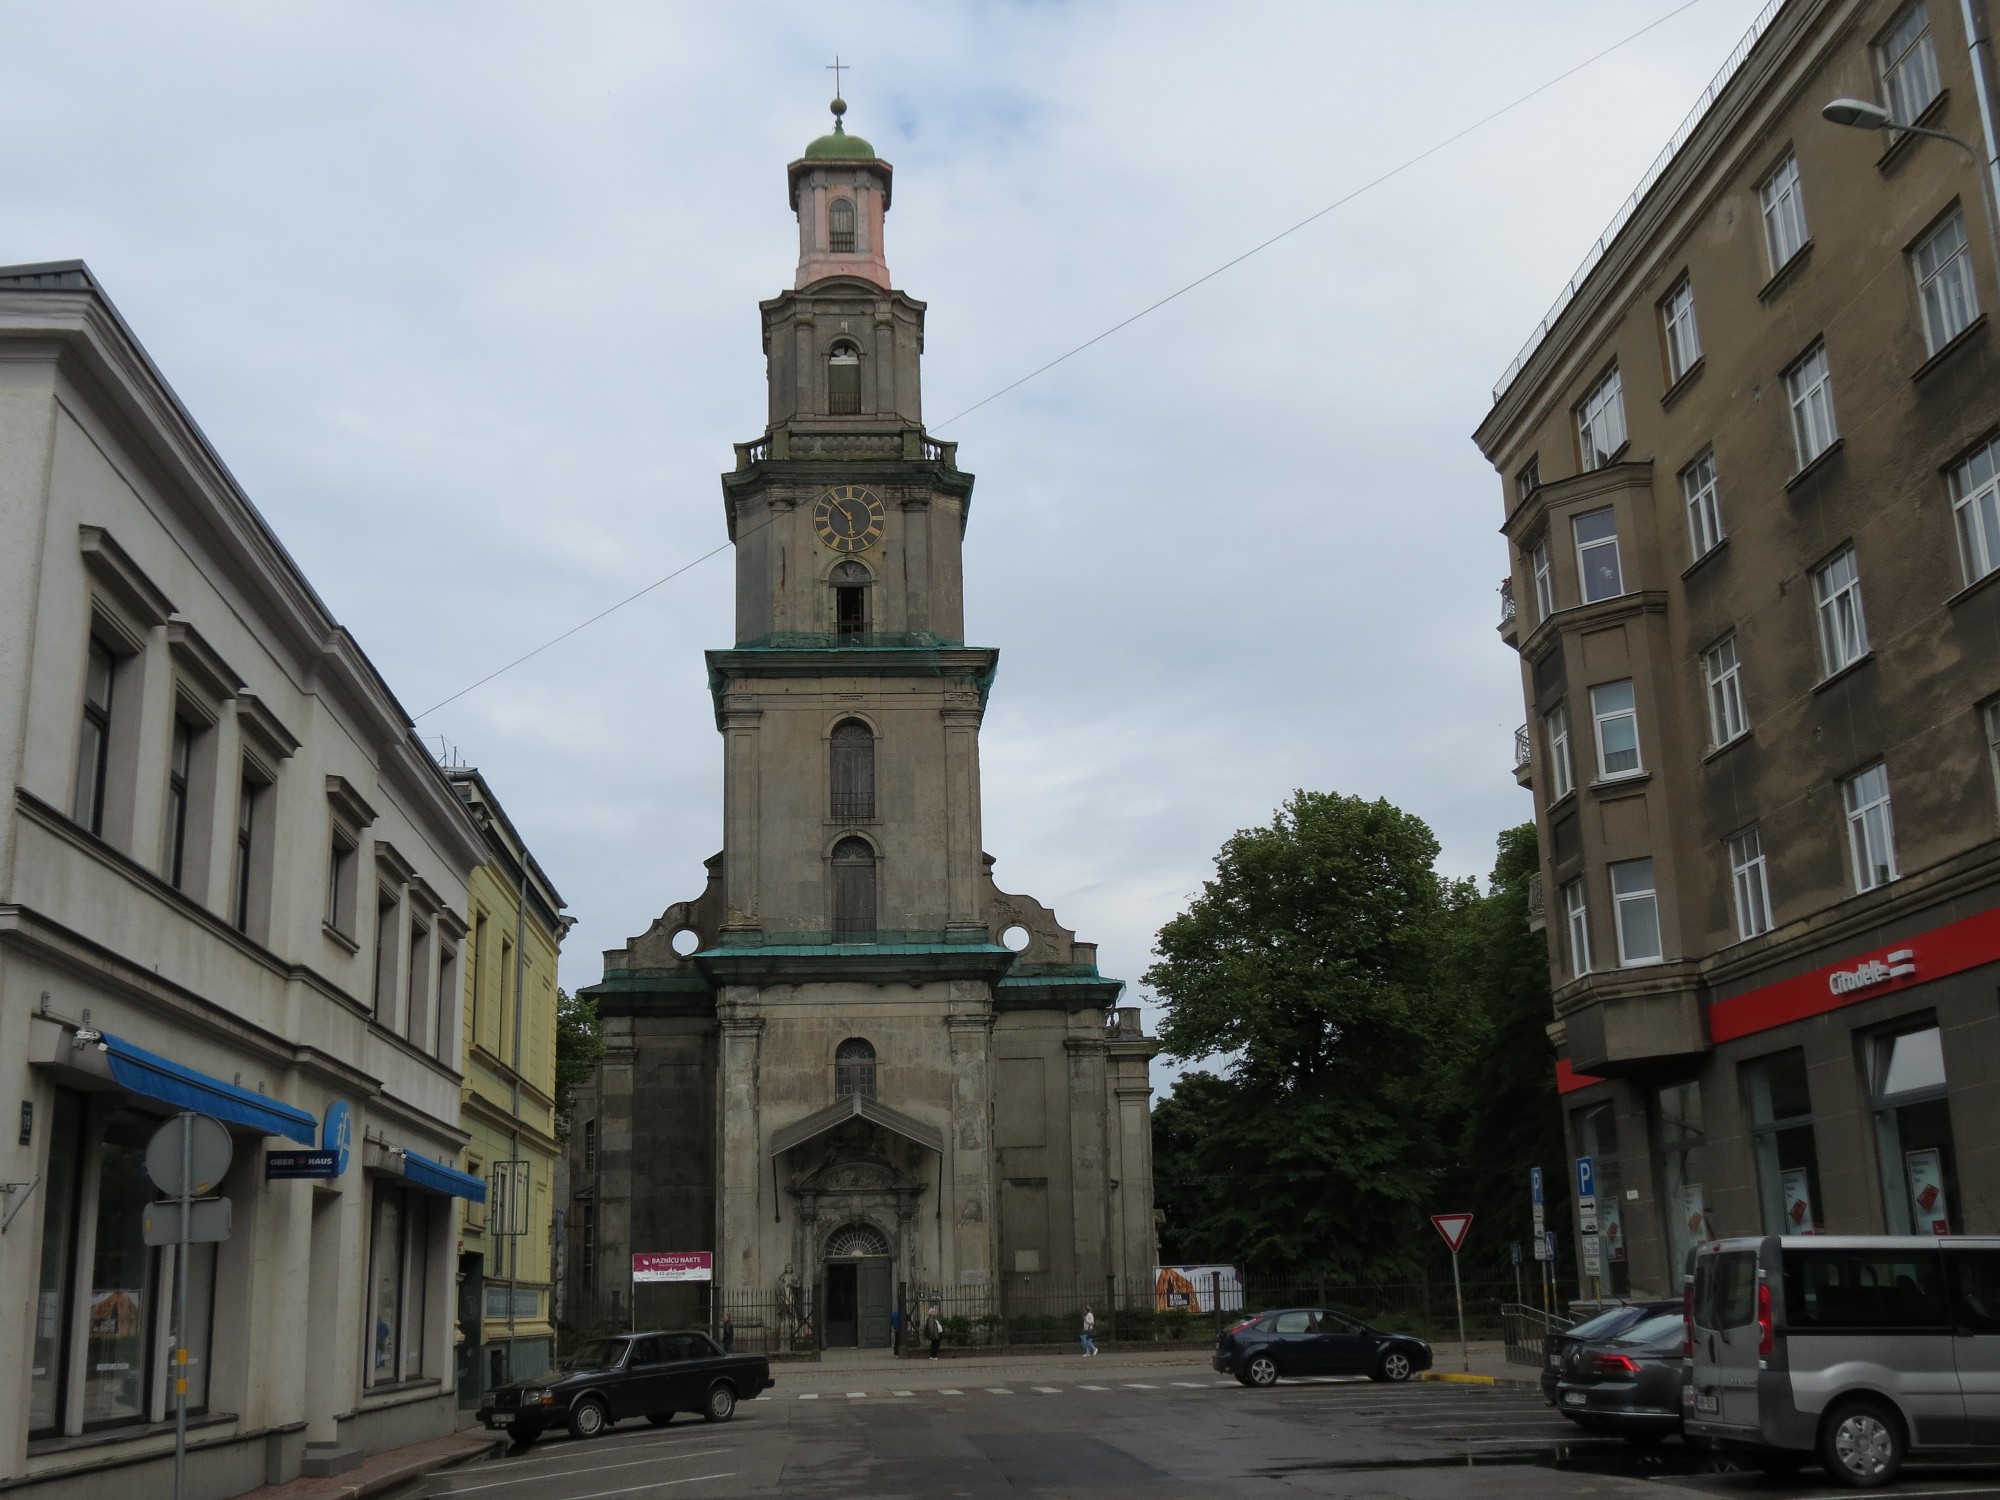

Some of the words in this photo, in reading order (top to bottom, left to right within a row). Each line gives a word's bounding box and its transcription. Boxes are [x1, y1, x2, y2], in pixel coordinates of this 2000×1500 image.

[1829, 960, 1890, 995] Citadele
[270, 1158, 295, 1166] OBER
[308, 1157, 333, 1165] HAUS
[1533, 1172, 1540, 1200] P
[1580, 1162, 1591, 1193] P
[680, 1256, 701, 1264] NAKTS
